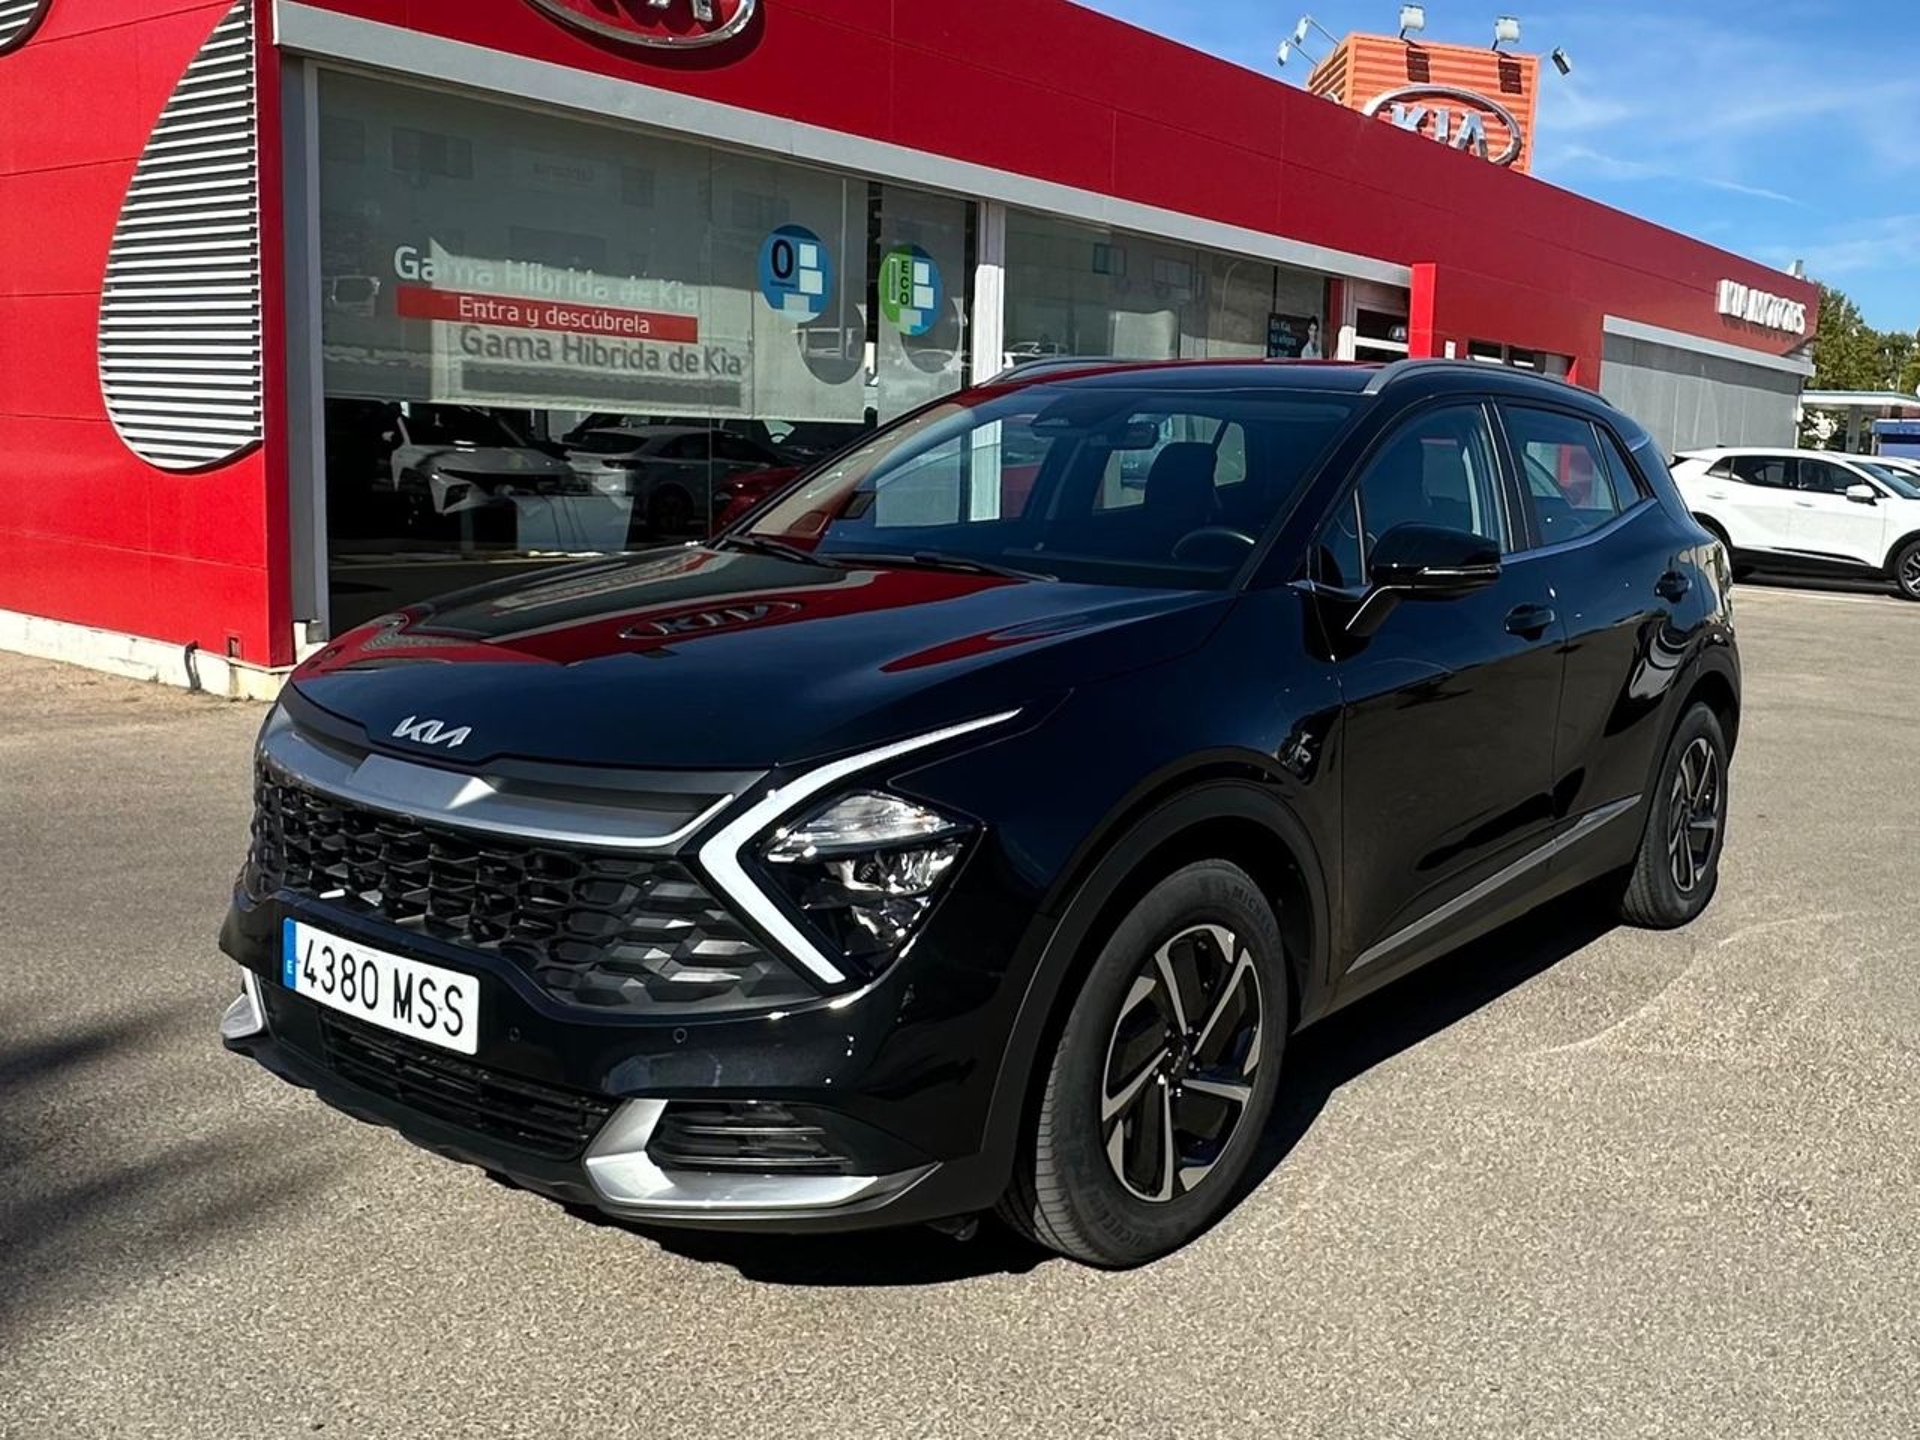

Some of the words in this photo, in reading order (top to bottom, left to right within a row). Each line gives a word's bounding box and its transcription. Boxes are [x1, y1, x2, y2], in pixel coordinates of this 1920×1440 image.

[394, 246, 495, 288] Gama
[658, 279, 699, 311] Kia
[771, 239, 794, 280] 0
[900, 260, 910, 305] ECO
[459, 297, 519, 322] Entra
[527, 307, 539, 327] y
[545, 307, 650, 334] descúbrela
[460, 325, 553, 361] Gama
[668, 350, 701, 372] de
[704, 346, 742, 376] Kia
[392, 715, 472, 748] KIA
[286, 959, 293, 974] E
[303, 938, 379, 1011] 4380
[393, 967, 464, 1037] MSS
